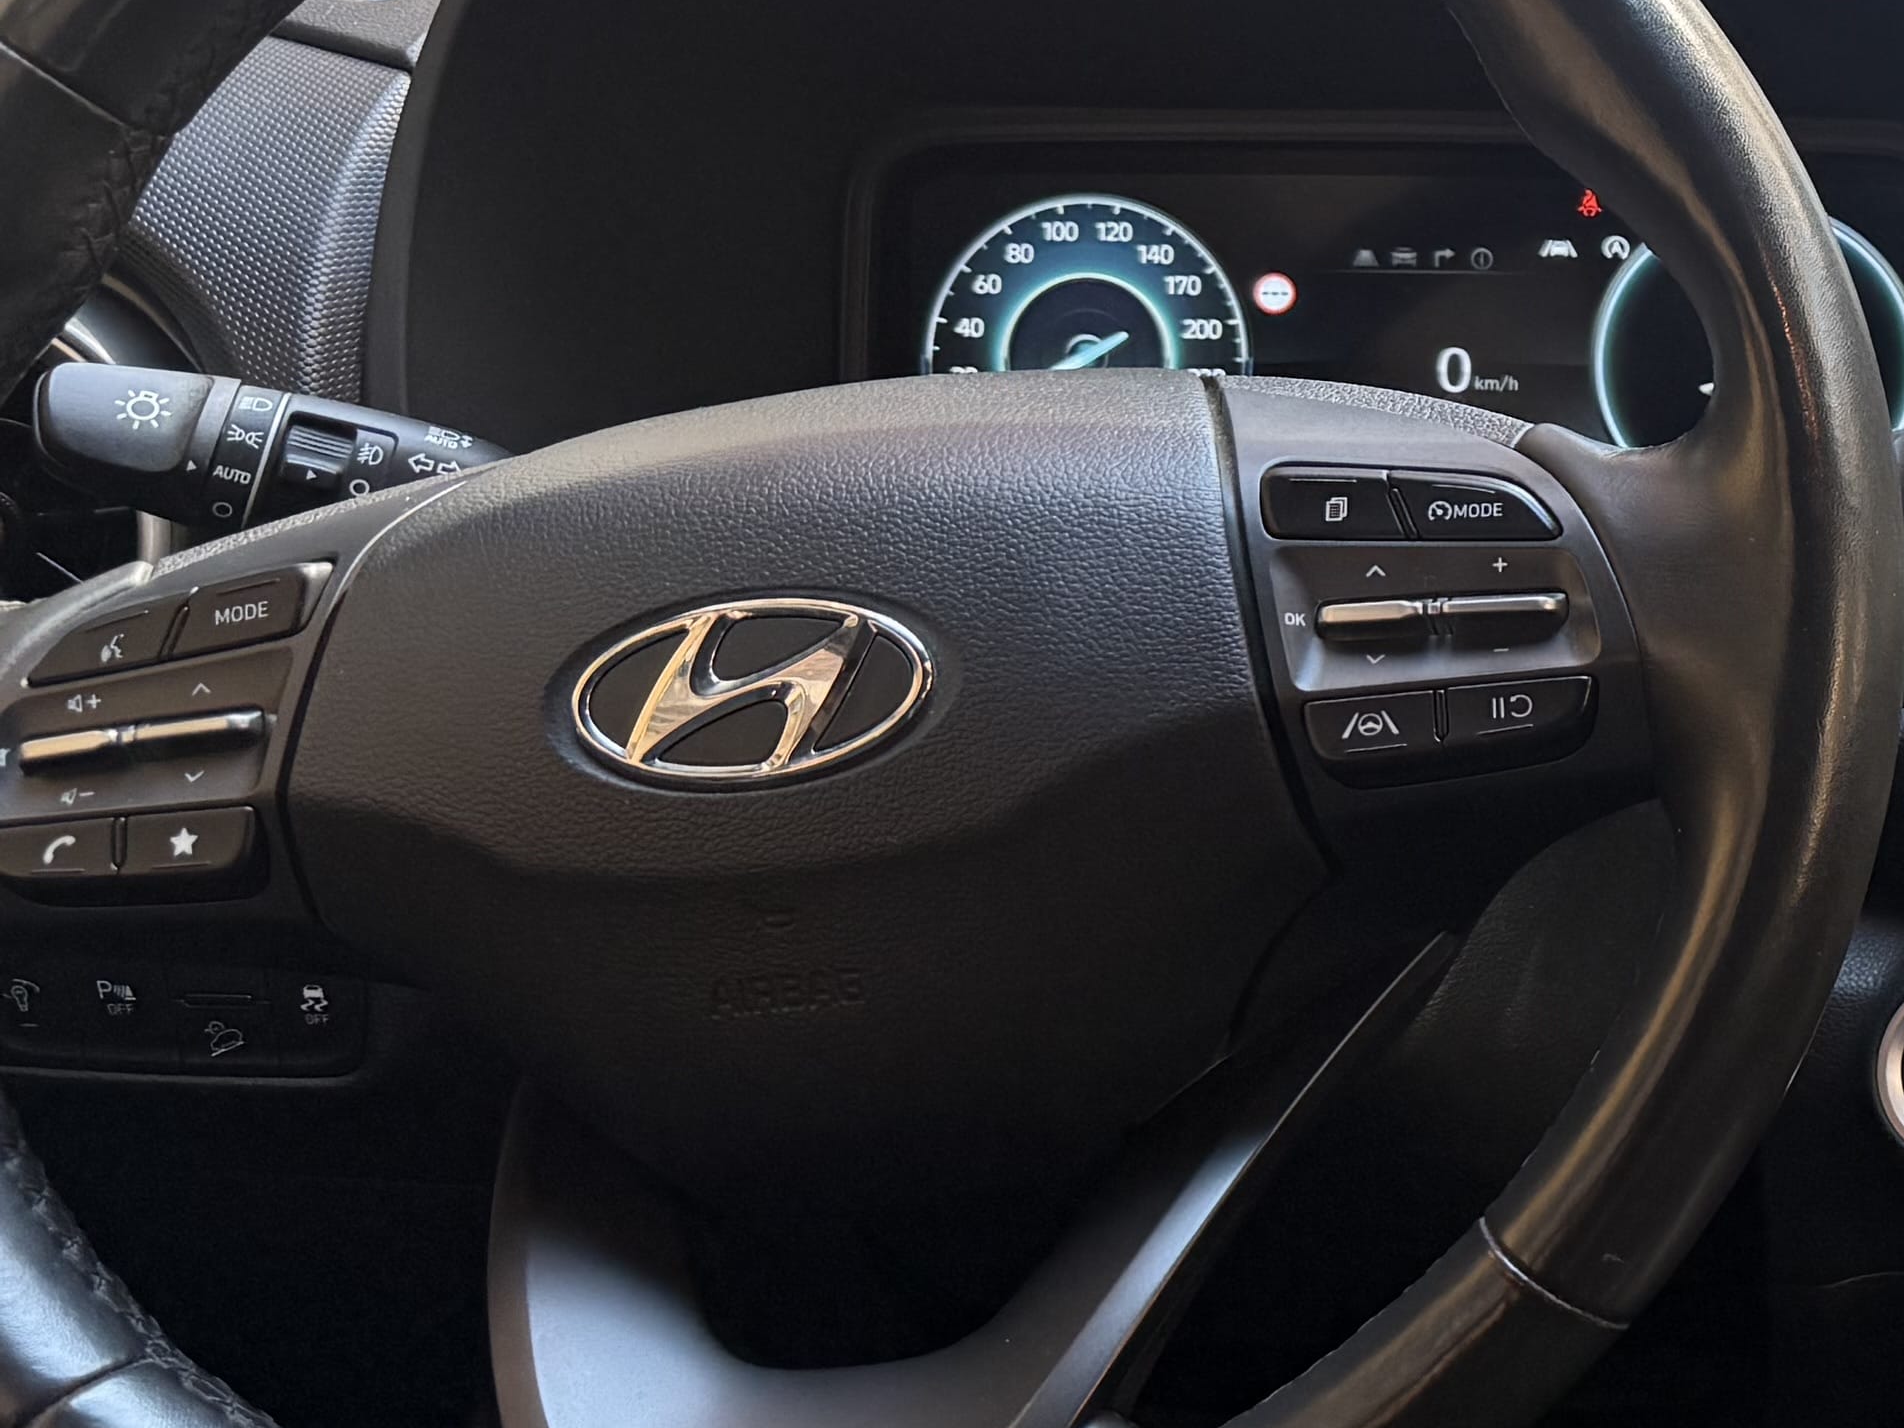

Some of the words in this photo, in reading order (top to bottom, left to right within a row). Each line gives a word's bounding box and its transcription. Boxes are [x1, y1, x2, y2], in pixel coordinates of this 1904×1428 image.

[1041, 220, 1079, 242] 100
[1095, 221, 1134, 243] 120
[1004, 242, 1035, 264] 80
[1136, 243, 1175, 265] 140
[972, 273, 1003, 295] 60
[1163, 275, 1202, 296] 170
[954, 317, 985, 338] 40
[1178, 318, 1223, 340] 200
[1437, 347, 1473, 394] 0
[1474, 374, 1519, 392] km/h
[424, 434, 459, 450] AUTO
[212, 463, 253, 486] AUTO
[1452, 501, 1504, 519] MODE
[214, 600, 269, 626] MODE
[107, 1003, 135, 1015] OFF
[304, 1014, 330, 1025] OFF
